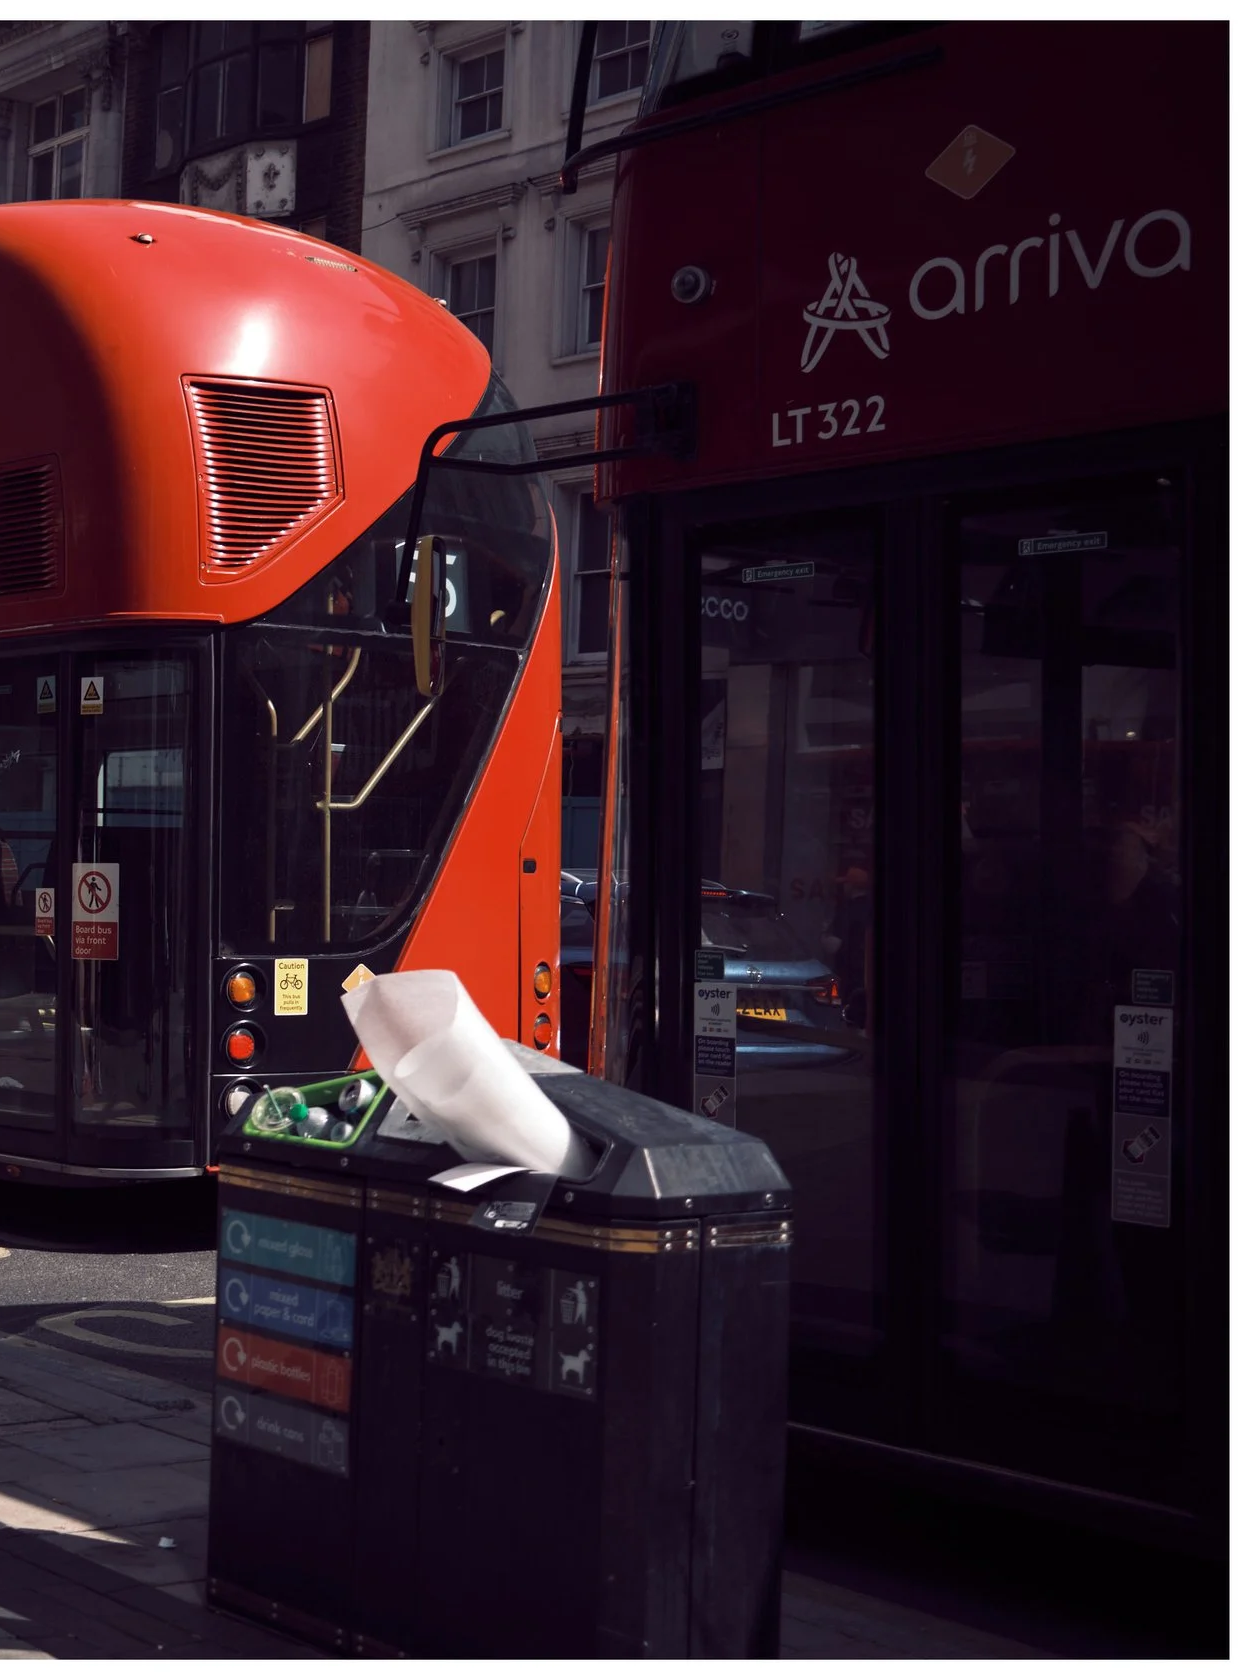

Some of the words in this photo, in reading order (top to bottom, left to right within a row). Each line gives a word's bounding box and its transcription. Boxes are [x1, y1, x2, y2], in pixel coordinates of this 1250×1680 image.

[908, 208, 1191, 320] arriva
[817, 394, 886, 442] 322
[1037, 539, 1081, 551] Emergency
[1083, 536, 1102, 546] exit
[757, 569, 793, 579] Emergency
[794, 566, 810, 575] exit
[75, 925, 95, 934] Board
[97, 925, 112, 934] bus
[75, 936, 85, 944] via
[86, 936, 107, 945] front
[75, 946, 91, 955] door
[278, 962, 305, 970] Caution
[698, 988, 730, 1000] oyster
[1119, 1012, 1164, 1027] oyster
[257, 1237, 288, 1253] mixed
[289, 1241, 313, 1259] glass
[269, 1287, 299, 1307] mixed
[496, 1279, 525, 1300] litter
[253, 1303, 282, 1320] paper
[282, 1306, 290, 1321] &
[292, 1312, 314, 1327] card
[251, 1354, 278, 1374] plastic
[280, 1361, 310, 1382] bottles
[256, 1415, 281, 1436] drink
[282, 1427, 304, 1443] cans
